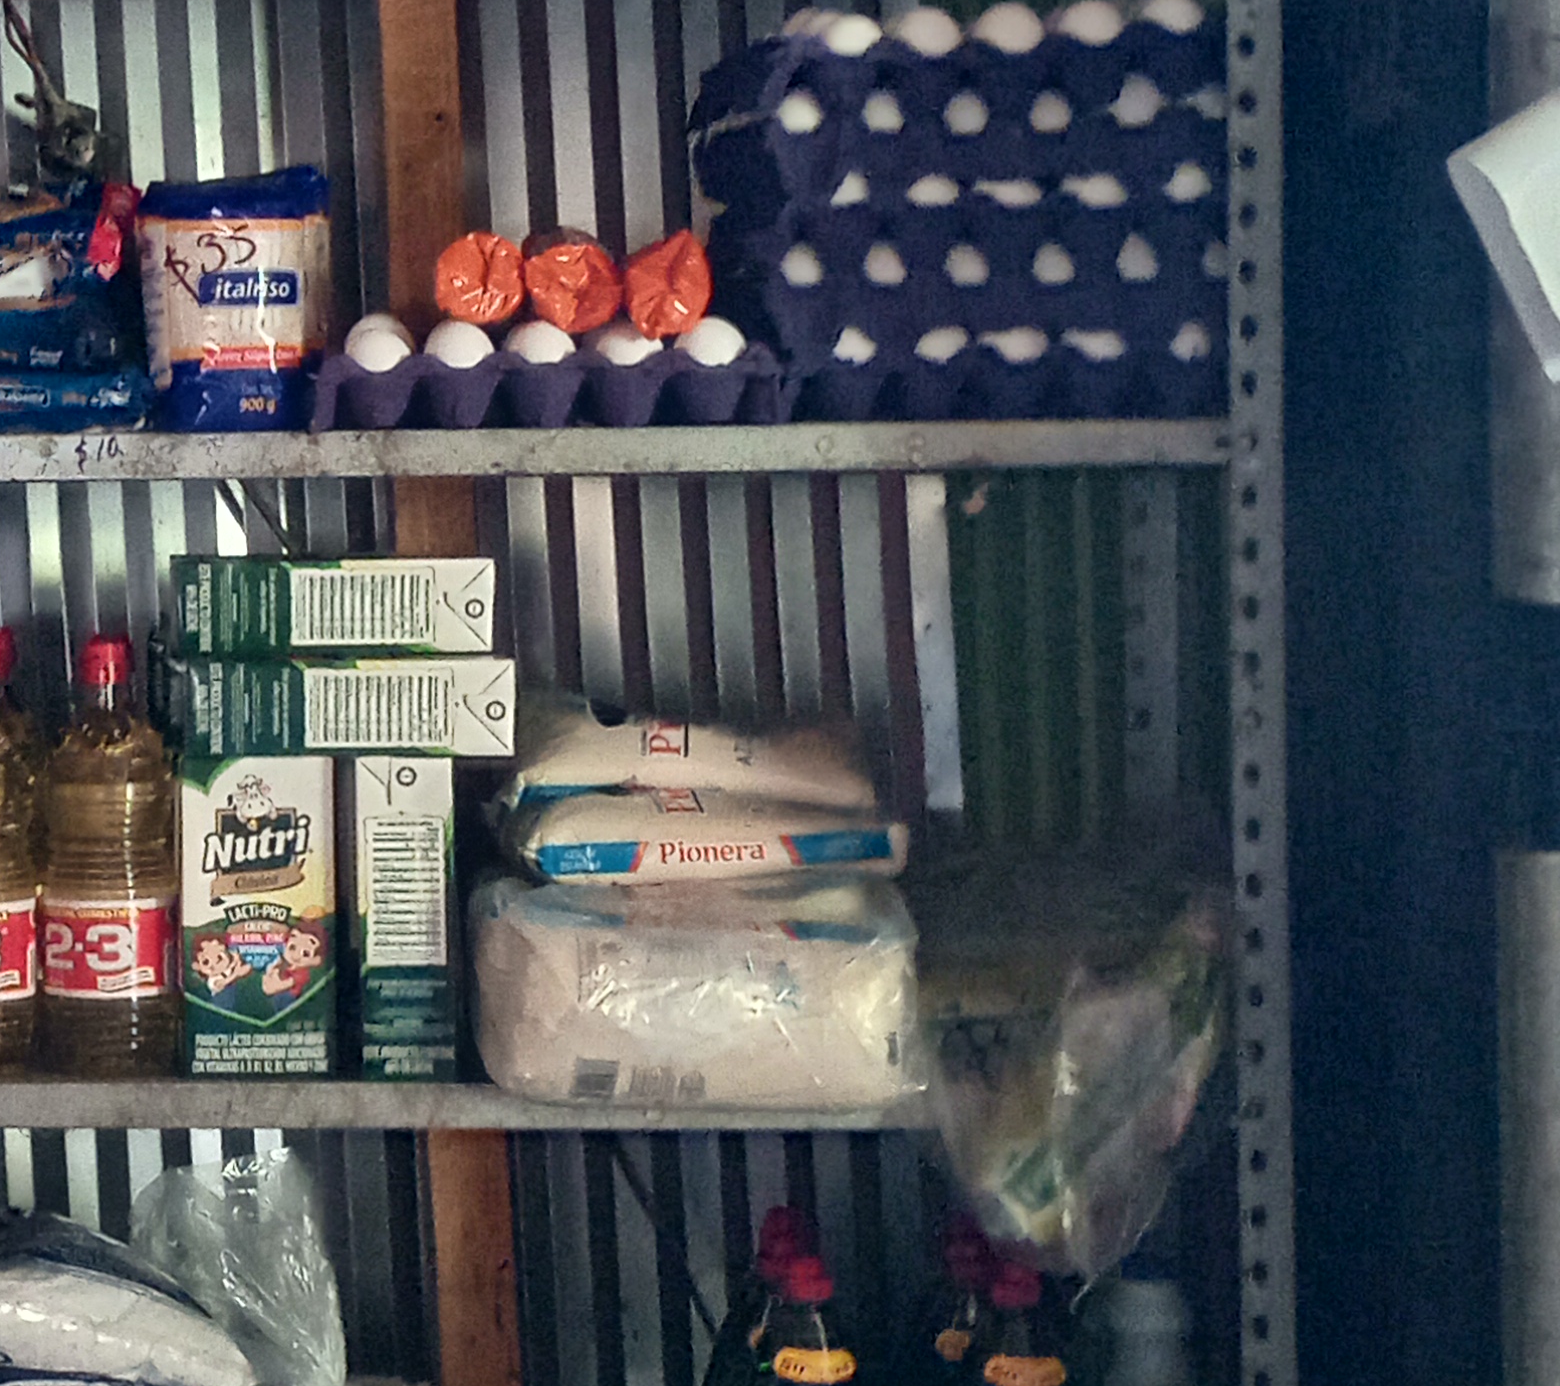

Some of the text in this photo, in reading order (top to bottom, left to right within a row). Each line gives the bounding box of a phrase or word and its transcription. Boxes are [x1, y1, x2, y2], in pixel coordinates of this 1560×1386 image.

[214, 277, 290, 299] italriso
[203, 815, 312, 873] Nutri
[659, 841, 766, 865] Pionera
[228, 904, 288, 923] LACTI-PRO
